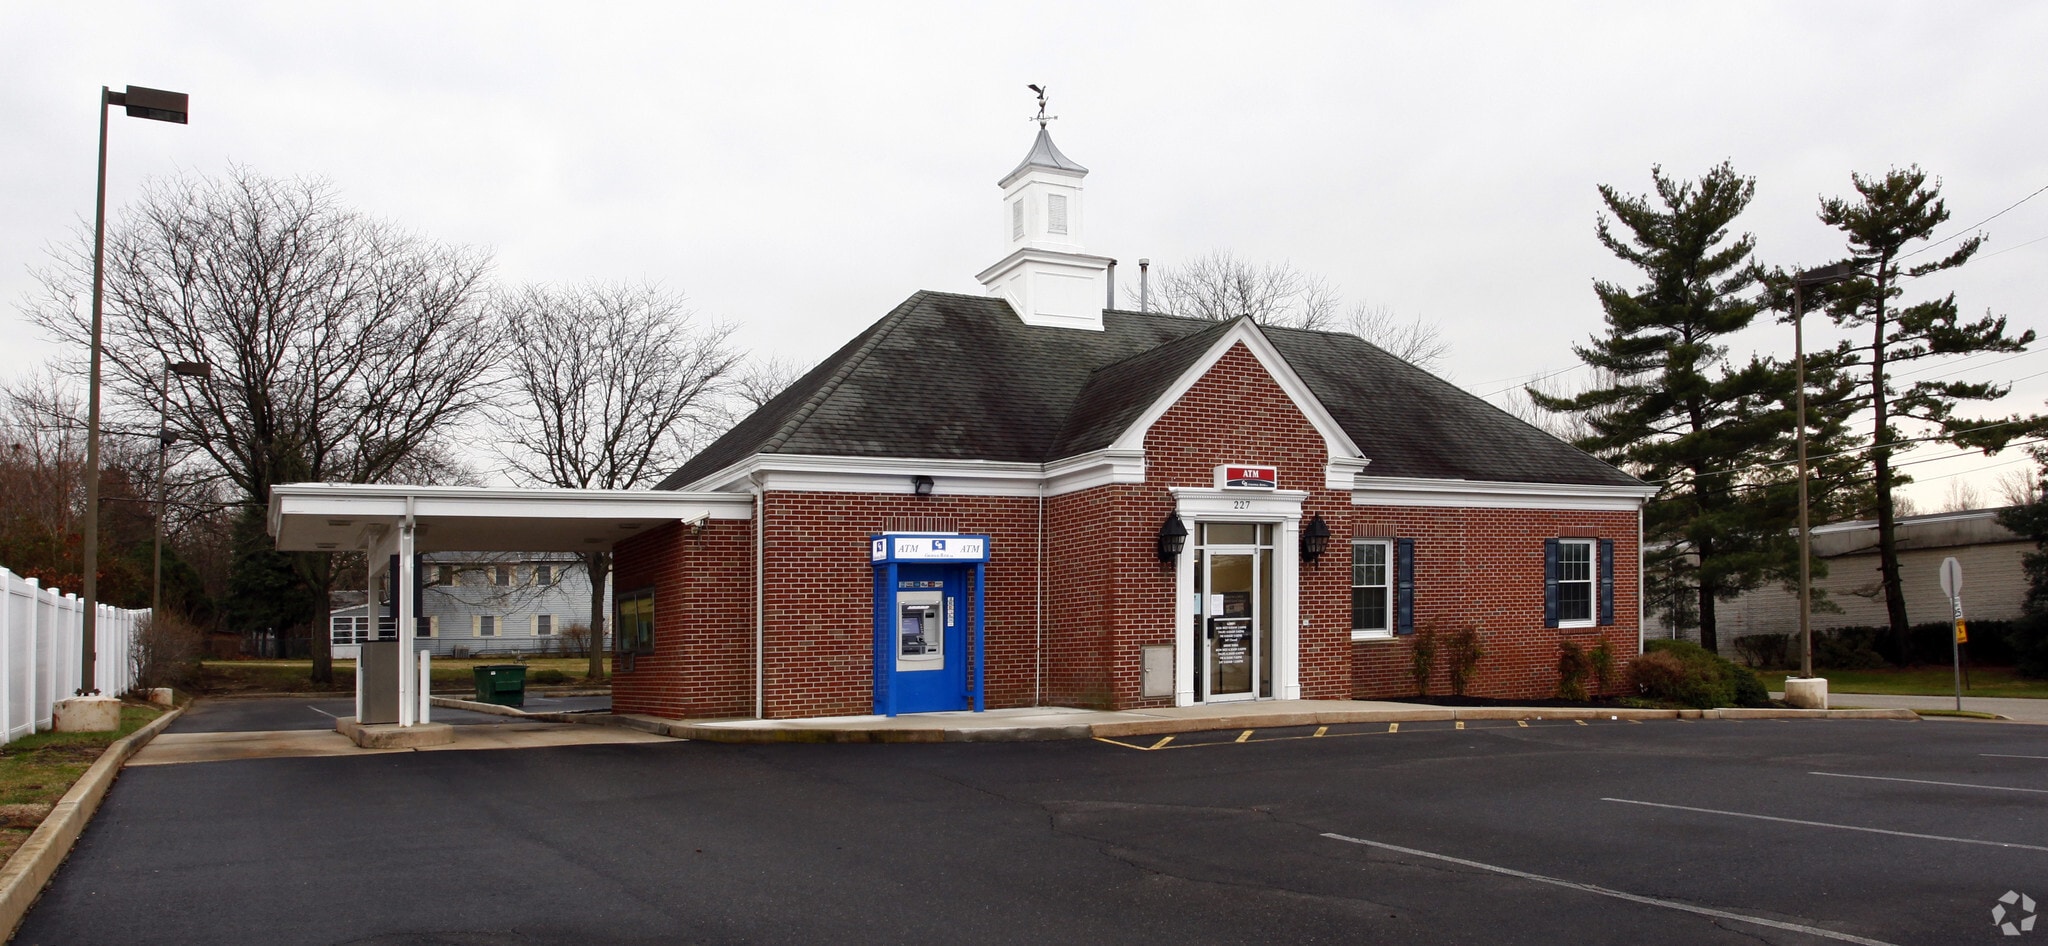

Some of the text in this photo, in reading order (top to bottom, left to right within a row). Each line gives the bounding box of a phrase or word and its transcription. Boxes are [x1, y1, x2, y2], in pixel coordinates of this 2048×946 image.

[1243, 470, 1259, 478] ATM
[1234, 501, 1250, 509] 227
[898, 544, 919, 552] ATM
[960, 544, 980, 552] ATM
